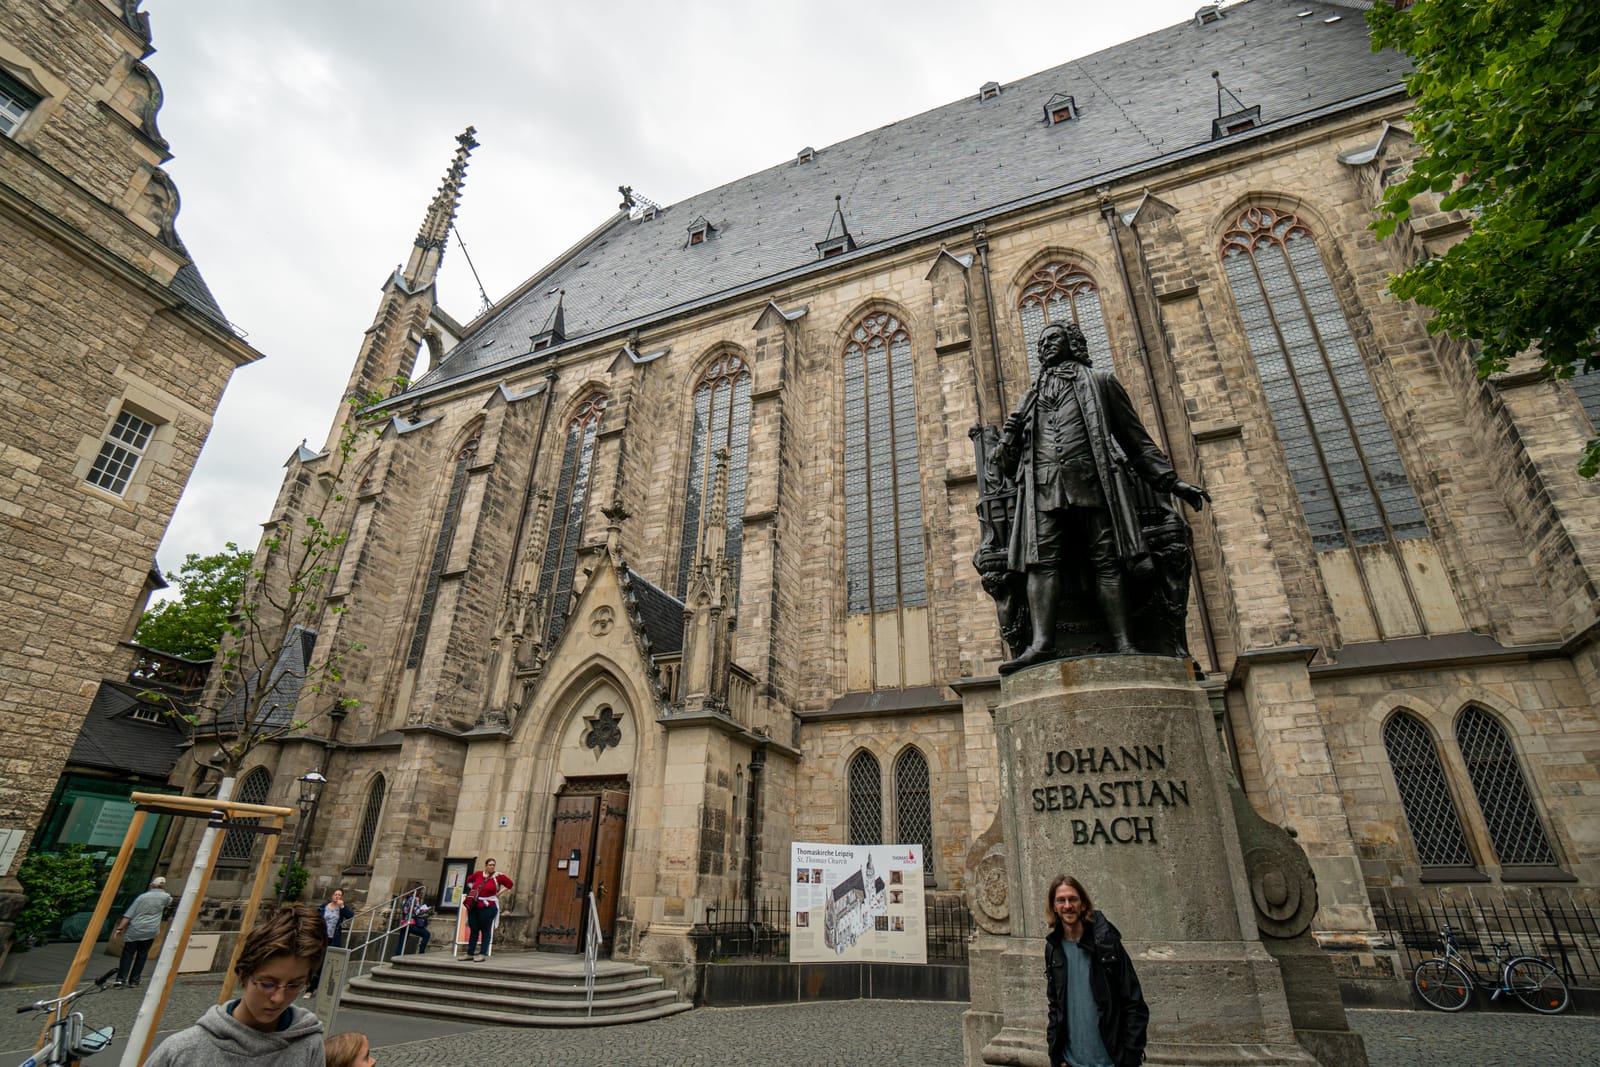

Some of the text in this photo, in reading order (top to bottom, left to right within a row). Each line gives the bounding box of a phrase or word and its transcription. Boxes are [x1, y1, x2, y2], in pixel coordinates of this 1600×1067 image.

[1045, 745, 1166, 777] JOHANN
[1032, 780, 1190, 812] SEBASTIAN
[1071, 817, 1158, 845] BACH
[797, 848, 854, 859] Thomaskirche Leipzig
